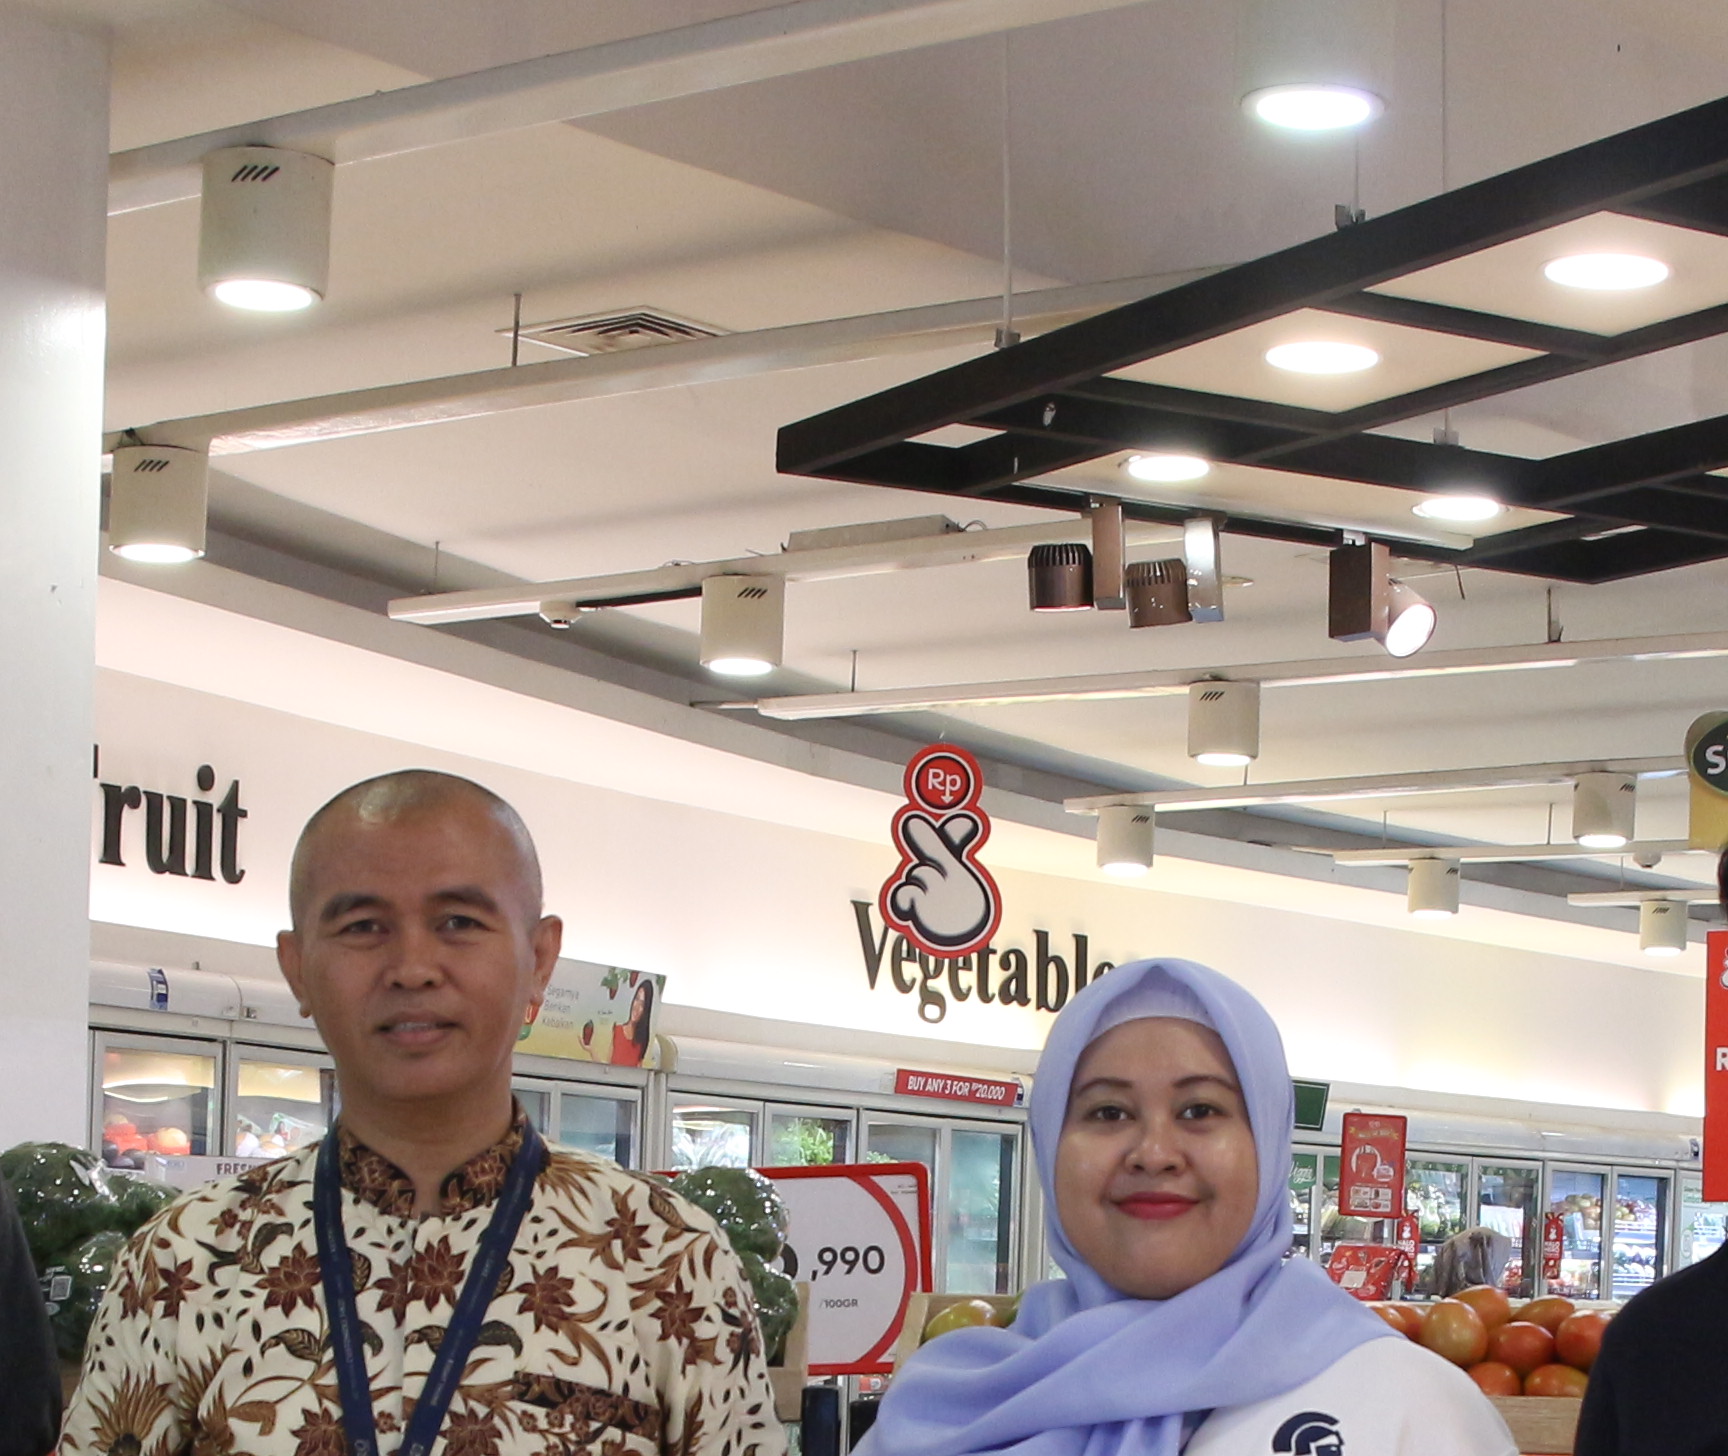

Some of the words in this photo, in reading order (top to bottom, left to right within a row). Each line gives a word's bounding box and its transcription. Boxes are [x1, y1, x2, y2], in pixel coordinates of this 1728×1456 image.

[928, 768, 962, 798] Rp
[93, 744, 248, 885] ruit
[908, 1076, 926, 1090] BUY
[926, 1078, 945, 1093] ANY
[945, 1080, 950, 1094] 3
[952, 1081, 970, 1096] FOR
